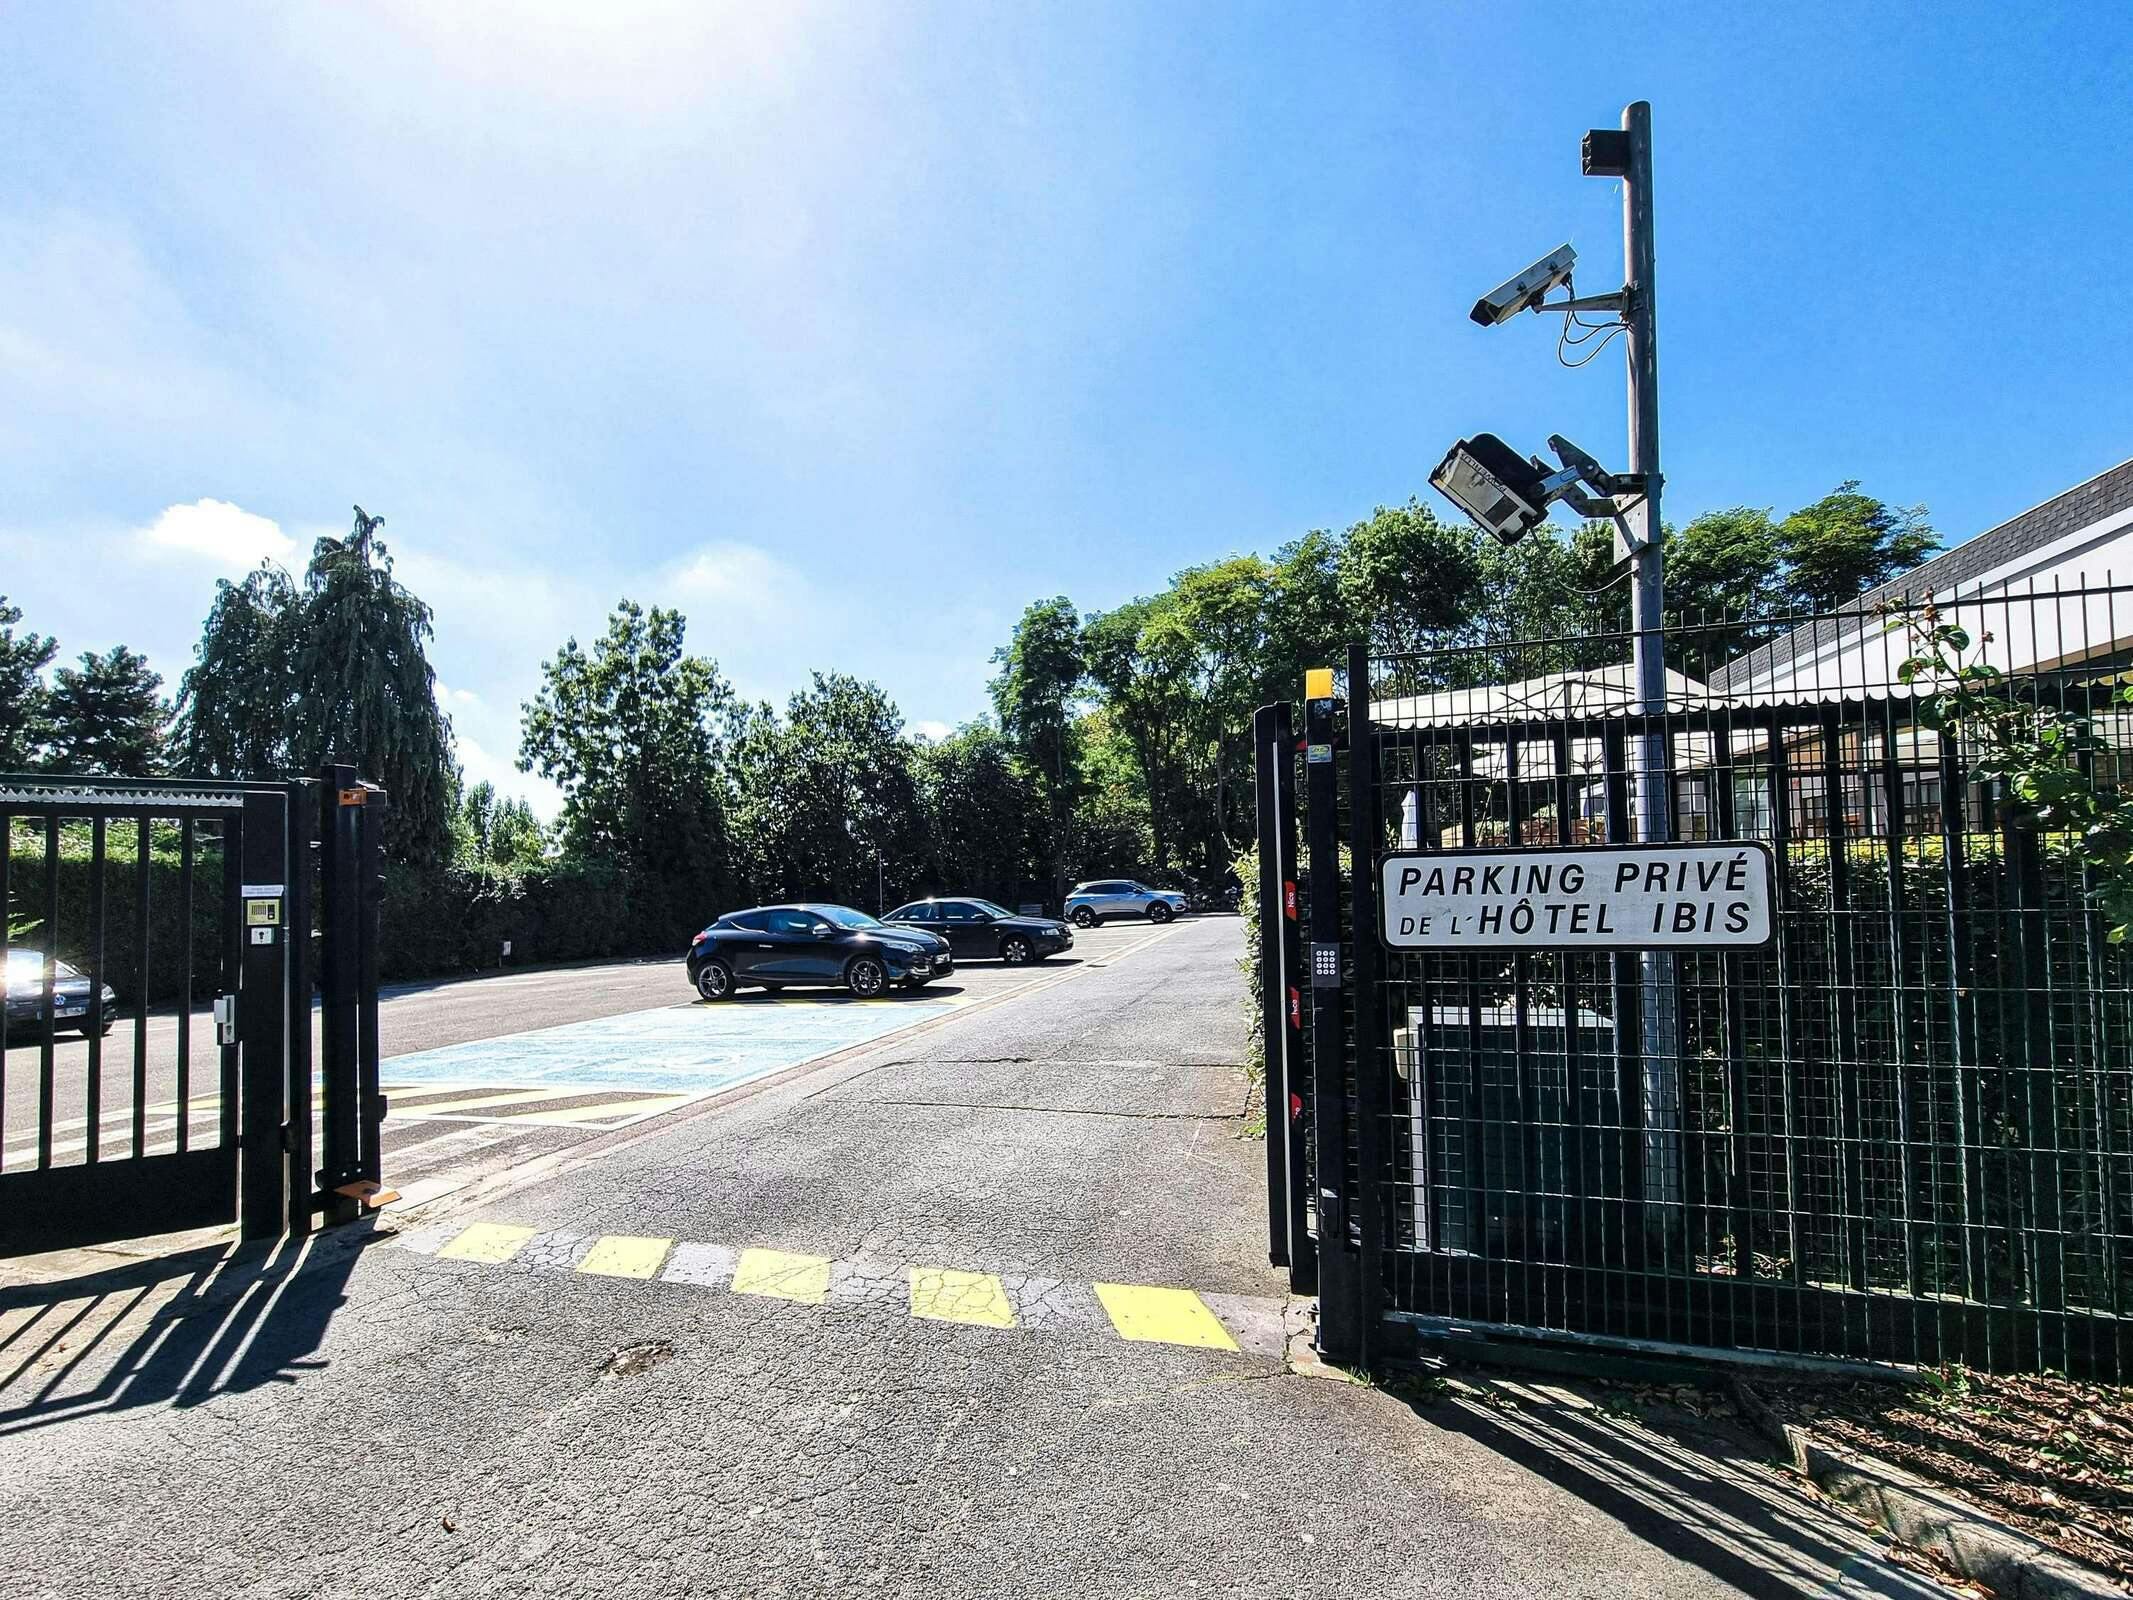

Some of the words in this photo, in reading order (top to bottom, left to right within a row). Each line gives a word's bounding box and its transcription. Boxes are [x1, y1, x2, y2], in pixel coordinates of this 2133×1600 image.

[1399, 862, 1586, 897] PARKING
[1614, 851, 1749, 893] PRIVÉ
[1400, 916, 1432, 936] DE
[1652, 901, 1751, 934] IBIS
